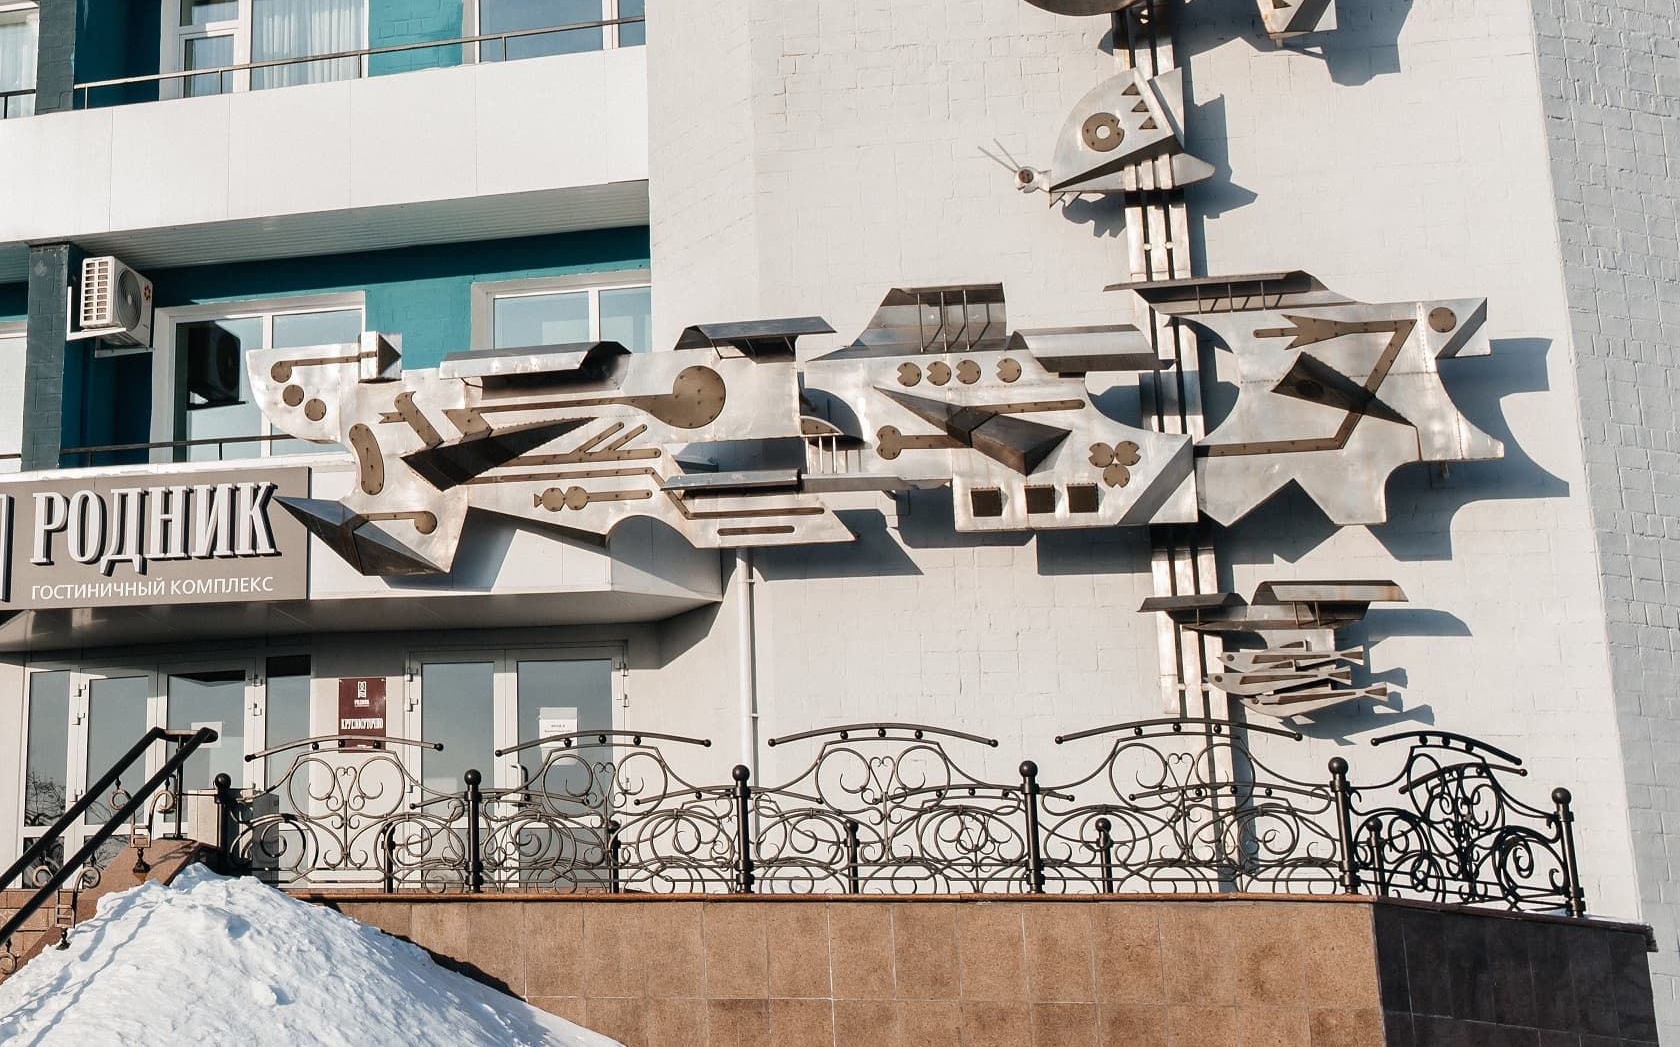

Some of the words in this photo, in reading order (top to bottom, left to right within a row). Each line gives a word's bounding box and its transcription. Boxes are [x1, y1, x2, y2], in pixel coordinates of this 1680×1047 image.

[29, 481, 281, 576] РОДНИК
[31, 577, 166, 601] ГОСТИНИЧНЫЙ
[170, 576, 274, 596] КОМПЛЕКС
